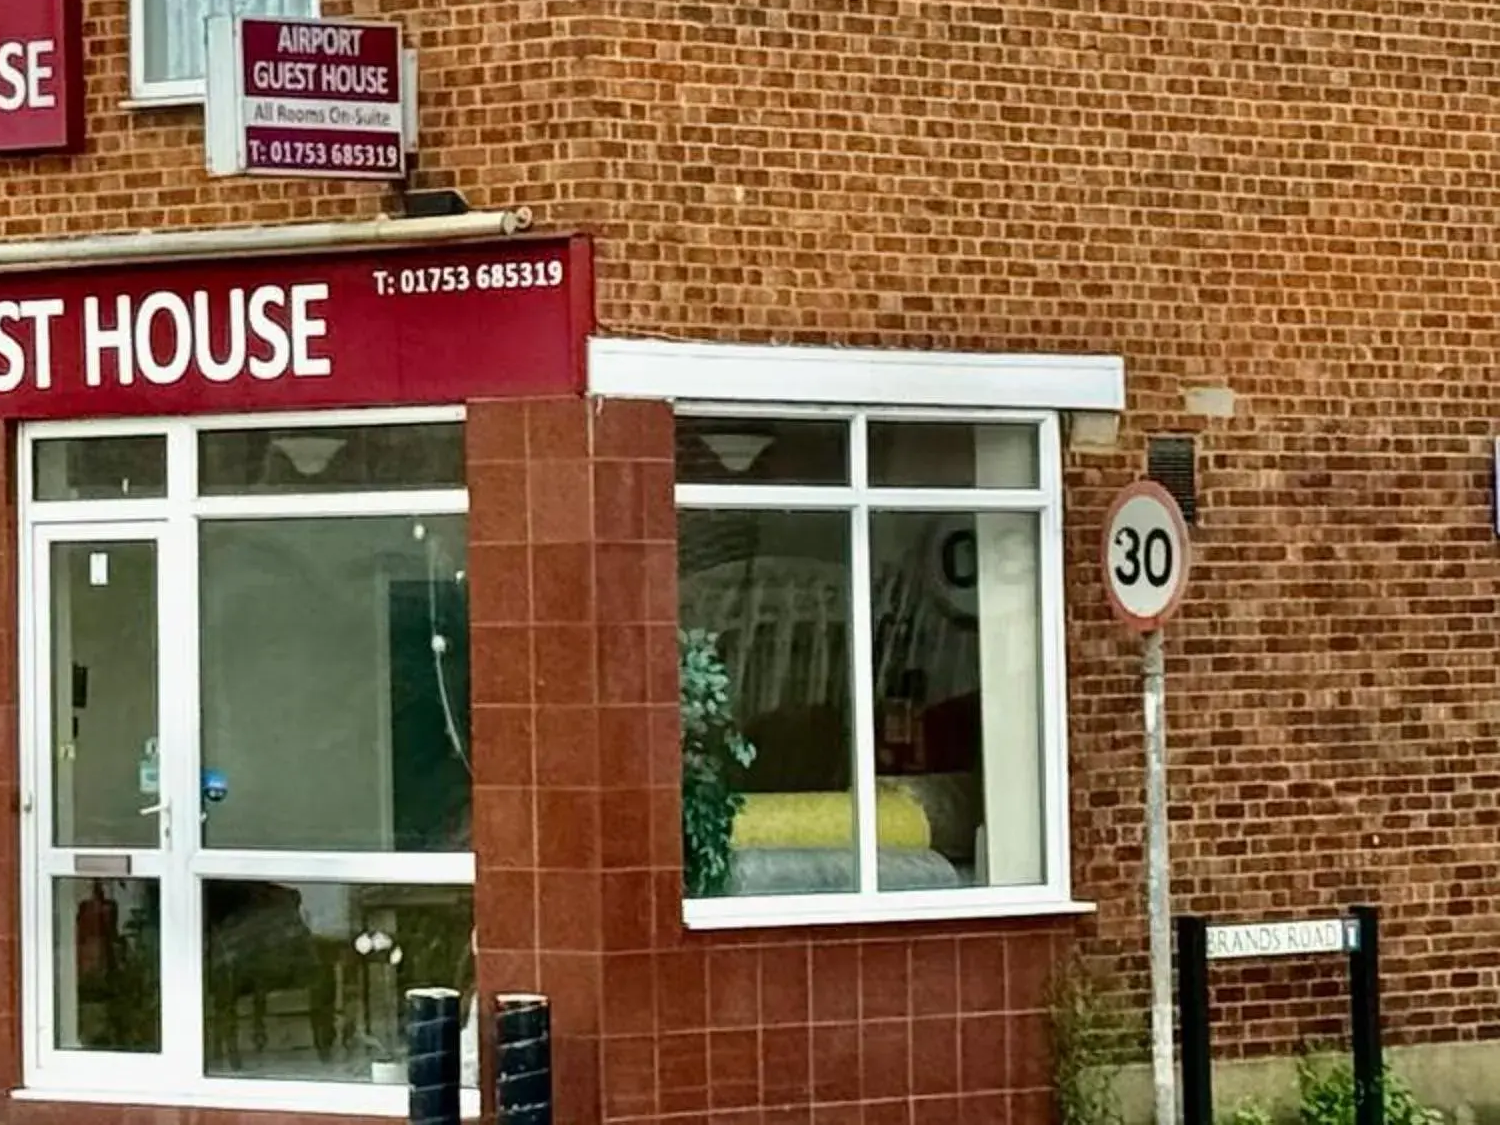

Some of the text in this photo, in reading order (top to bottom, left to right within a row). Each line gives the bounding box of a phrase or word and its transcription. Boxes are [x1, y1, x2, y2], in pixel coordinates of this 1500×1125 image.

[277, 25, 364, 56] AIRPORT
[253, 61, 389, 94] GUEST HOUSE
[254, 104, 273, 121] All
[277, 106, 325, 124] Rooms
[249, 140, 398, 167] T: 01753 685319
[372, 260, 563, 295] T: 01753 685319
[84, 283, 331, 386] HOUSE
[1114, 526, 1173, 587] 30
[1287, 922, 1338, 949] ROAD
